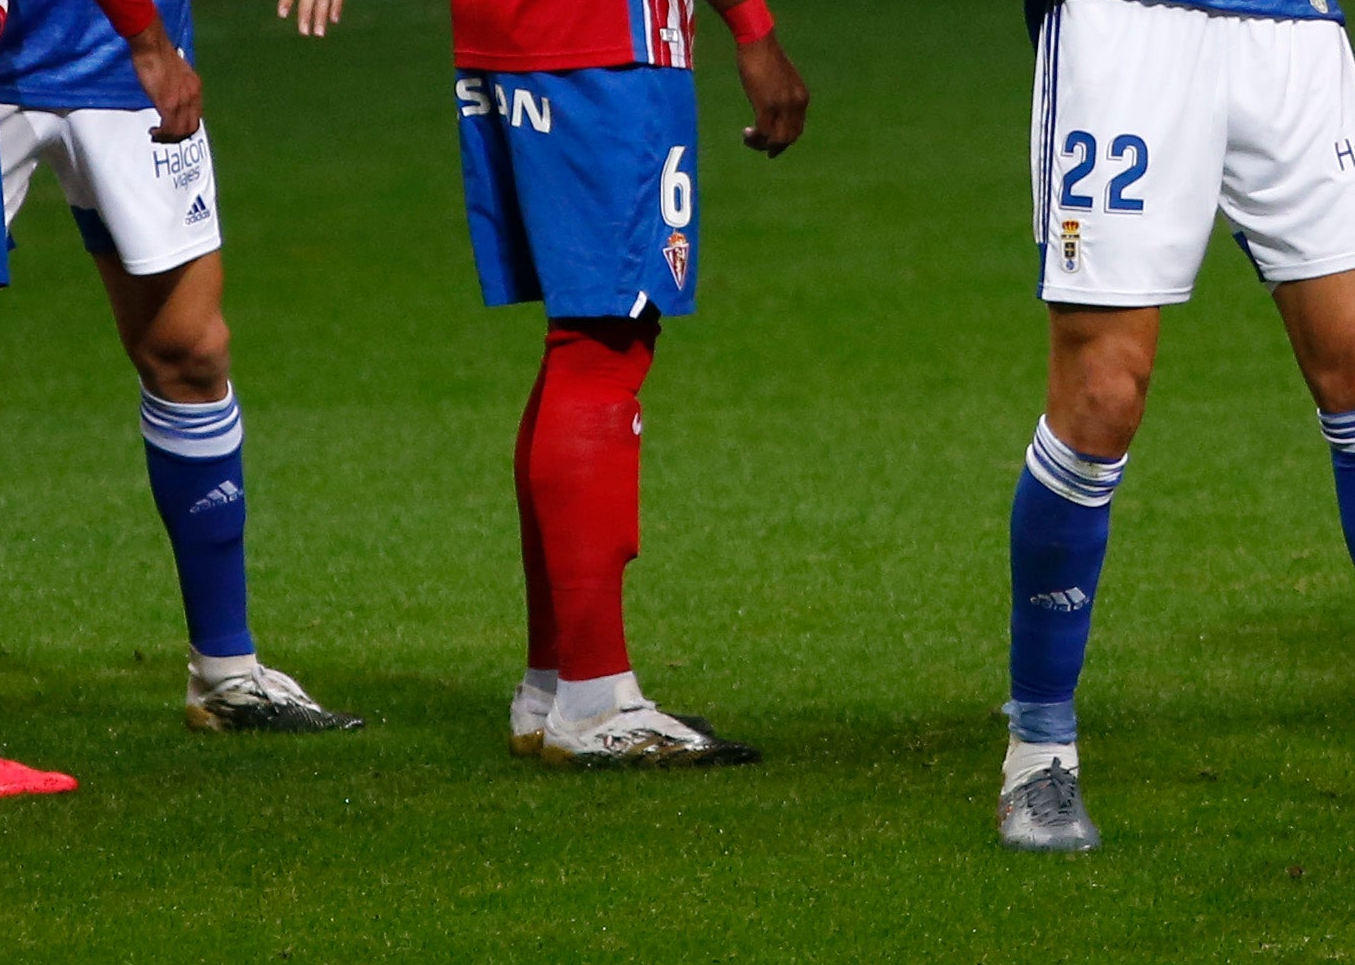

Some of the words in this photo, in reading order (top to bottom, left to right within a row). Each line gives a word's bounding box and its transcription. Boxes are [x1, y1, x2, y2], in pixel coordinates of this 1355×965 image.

[660, 146, 692, 228] 6
[1059, 130, 1149, 215] 22
[184, 210, 212, 225] adidas
